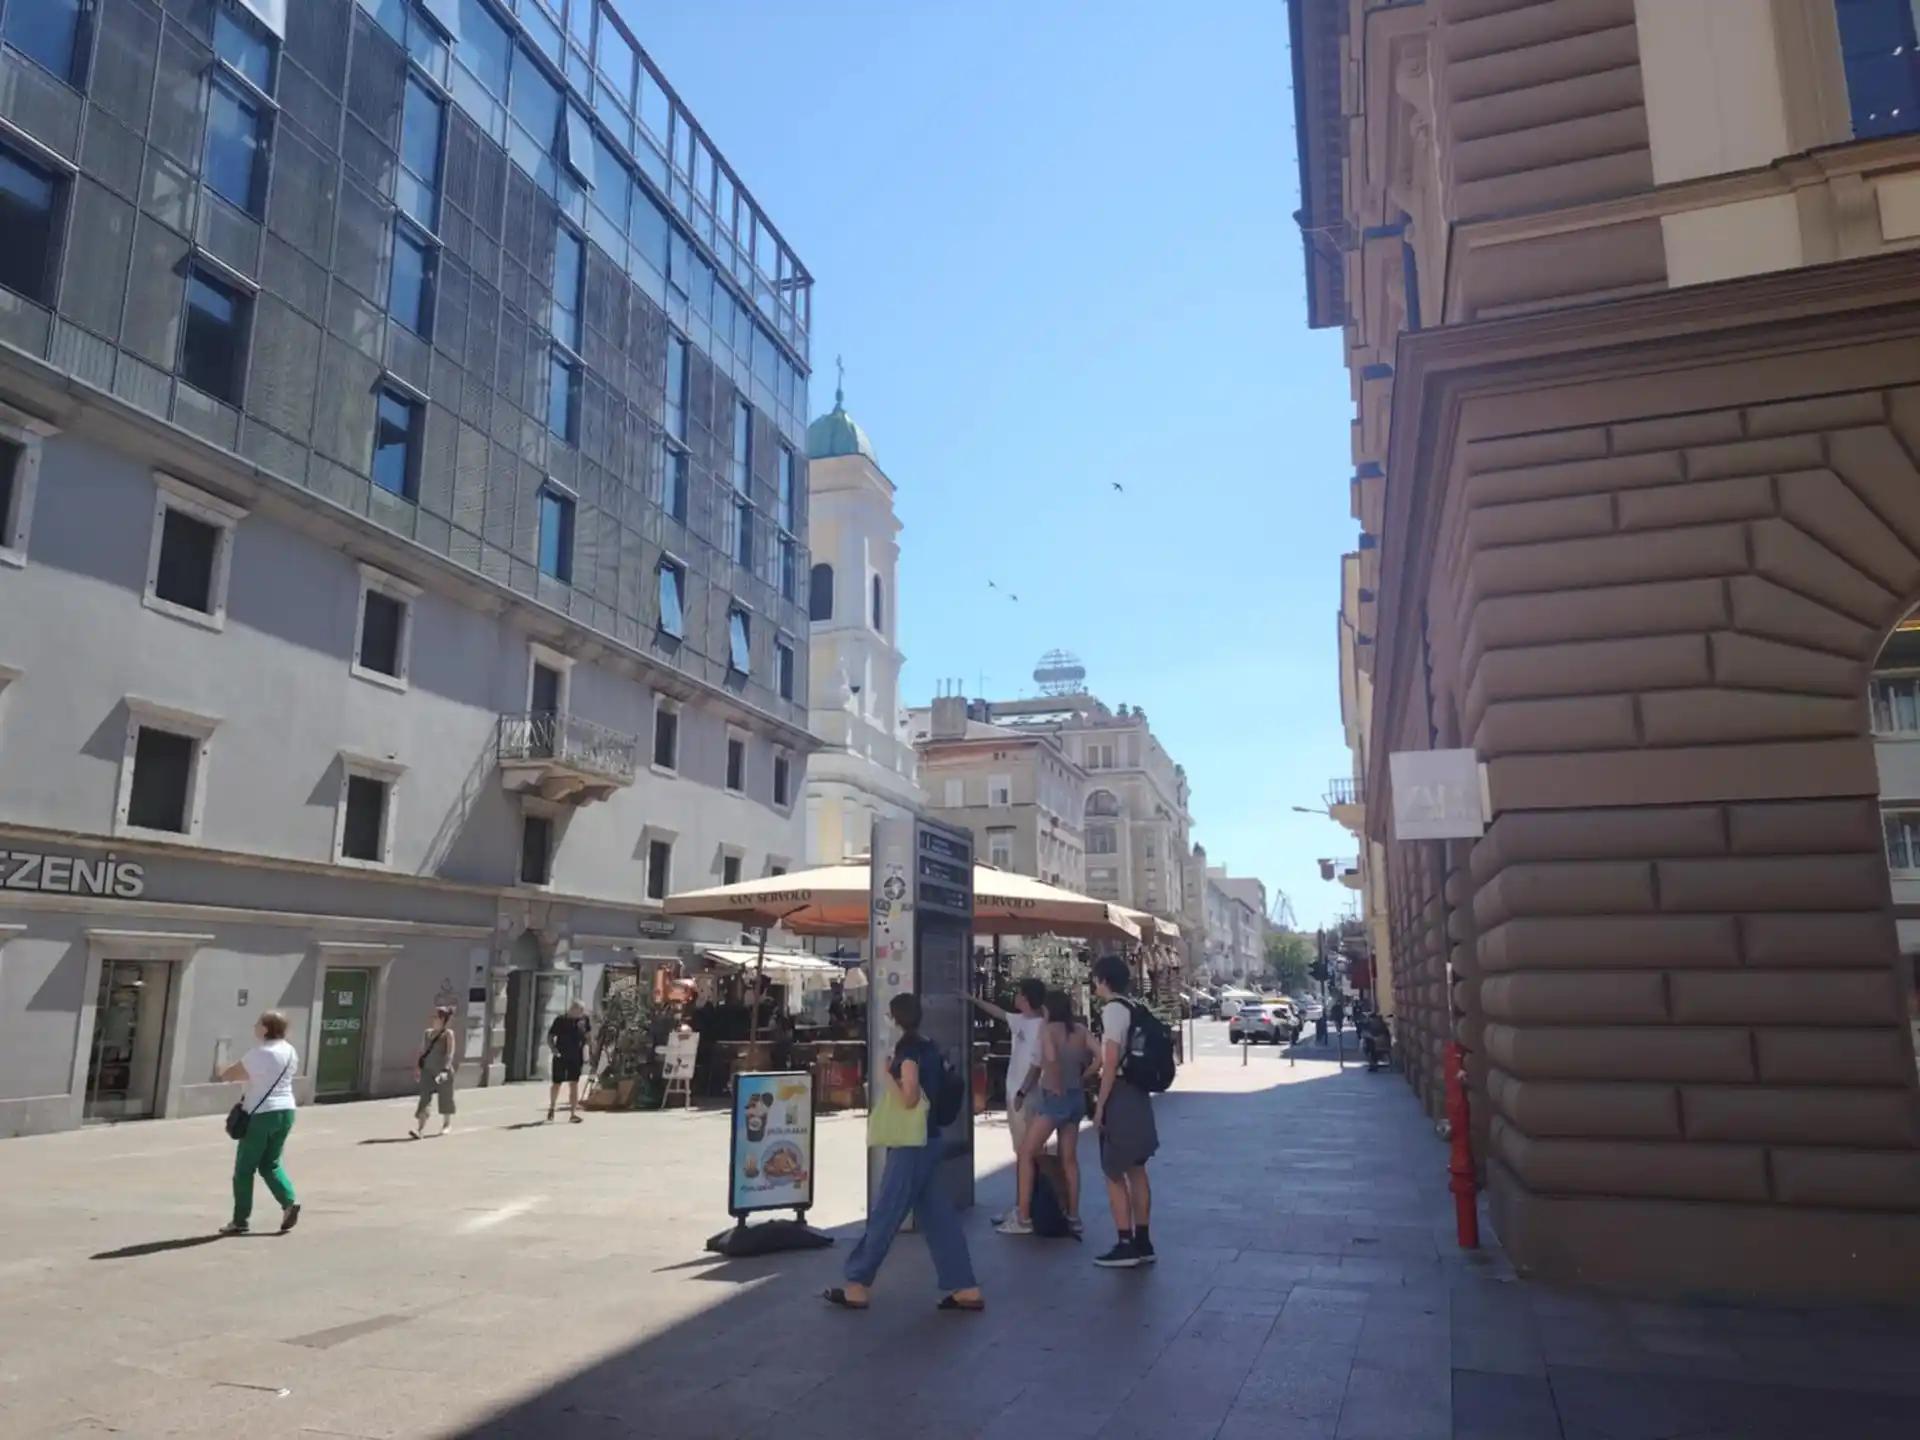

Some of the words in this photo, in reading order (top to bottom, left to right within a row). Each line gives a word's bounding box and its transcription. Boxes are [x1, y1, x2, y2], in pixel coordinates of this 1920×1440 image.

[0, 850, 144, 898] ZENiS
[729, 893, 753, 905] SAN
[757, 889, 812, 904] SERVOLO
[976, 894, 1036, 909] SERVOLO
